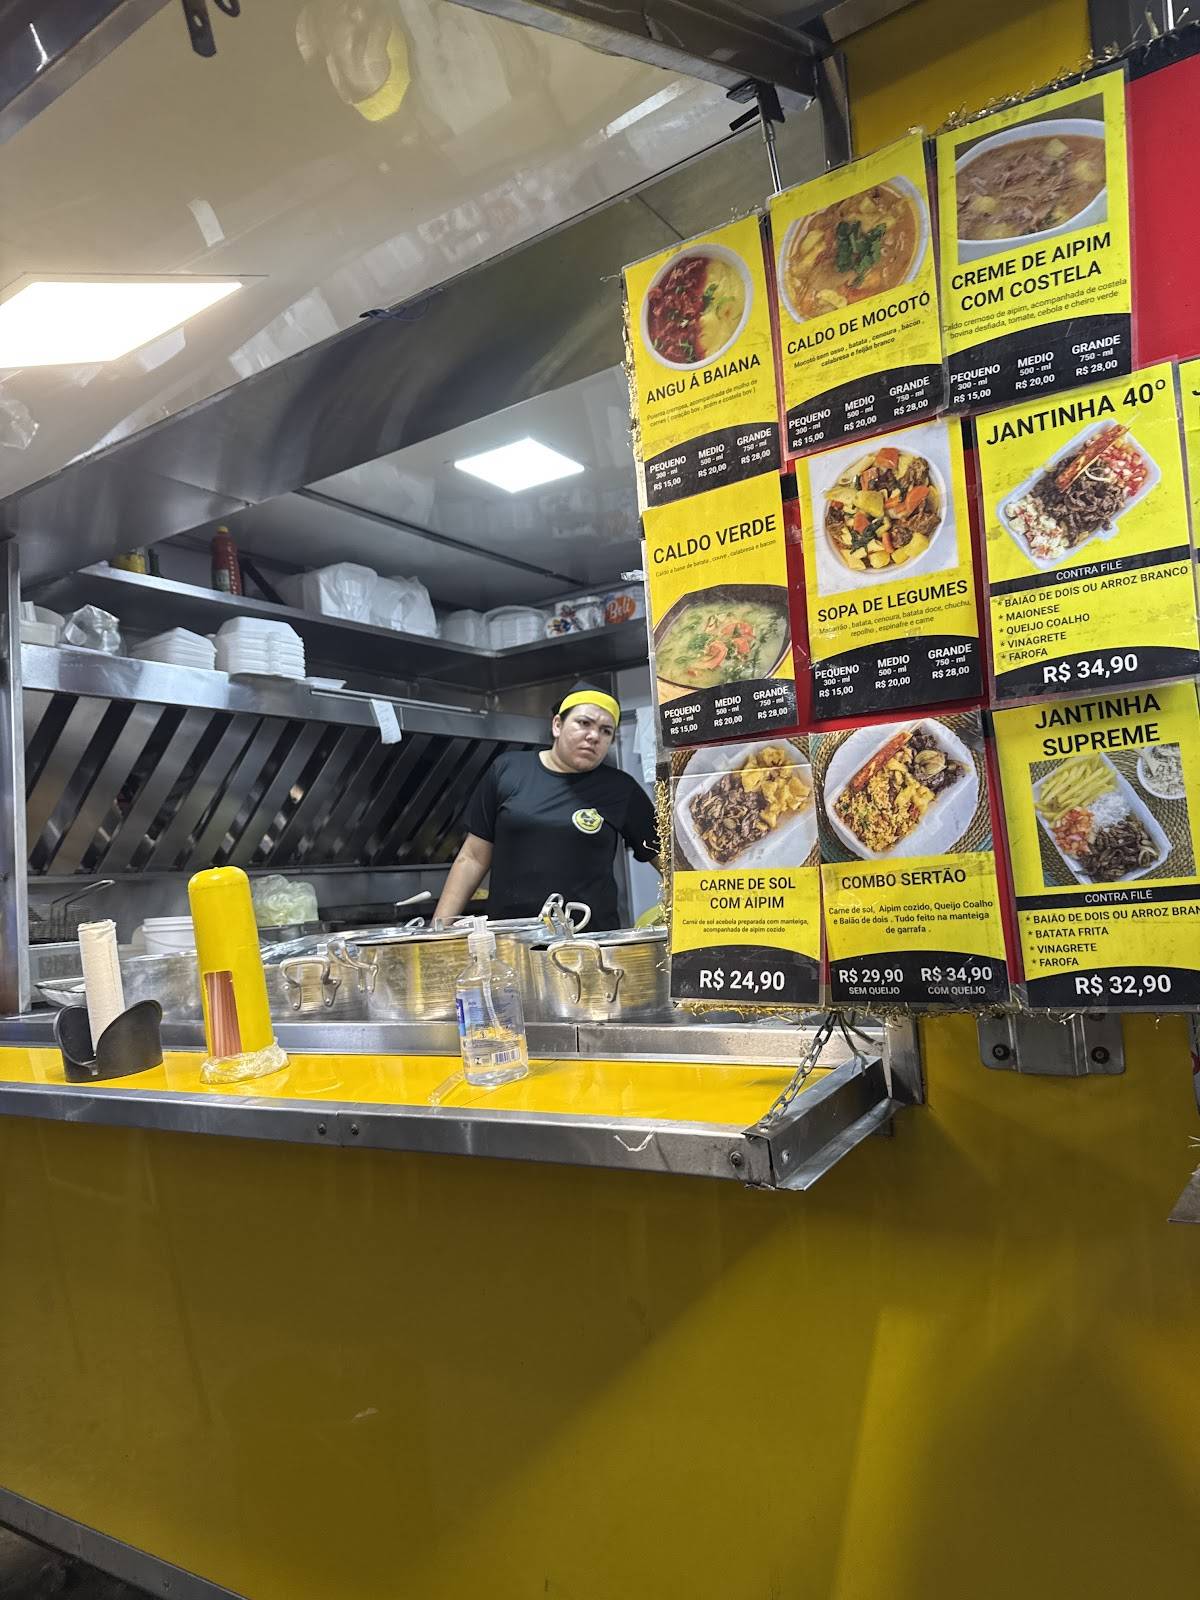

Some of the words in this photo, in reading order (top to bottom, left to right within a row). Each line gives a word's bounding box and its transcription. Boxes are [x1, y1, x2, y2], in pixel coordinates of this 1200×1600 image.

[952, 259, 1016, 290] CREME
[1022, 251, 1046, 271] DE
[1052, 232, 1111, 262] AIPIM
[961, 286, 1003, 311] COM
[1010, 261, 1101, 297] COSTELA
[964, 314, 994, 327] cremoso
[1030, 290, 1085, 309] acompanhada
[1086, 286, 1096, 294] de
[1098, 278, 1127, 291] costela
[787, 328, 834, 354] CALDO
[840, 319, 858, 336] DE
[863, 291, 930, 328] MOCOTÓ
[950, 328, 973, 339] bovina
[1037, 306, 1062, 317] cebola
[1071, 297, 1095, 308] cheiro
[1097, 291, 1118, 302] verde
[1072, 335, 1121, 355] GRANDE
[1017, 352, 1054, 368] MEDIO
[1076, 366, 1088, 376] R$
[1091, 360, 1117, 373] 28,00
[647, 380, 685, 404] ANGU
[690, 373, 700, 389] Á
[704, 354, 760, 384] BAIANA
[951, 364, 1000, 383] PEQUENO
[889, 376, 930, 396] GRANDE
[1016, 380, 1028, 390] R$
[1030, 374, 1055, 387] 20,00
[845, 395, 875, 411] MEDIO
[954, 394, 965, 403] R$
[968, 389, 991, 400] 15,00
[894, 407, 904, 416] R$
[906, 399, 928, 412] 28,00
[789, 409, 831, 429] PEQUENO
[844, 422, 854, 431] R$
[856, 415, 877, 428] 20,00
[987, 395, 1115, 445] JANTINHA
[737, 428, 771, 446] GRANDE
[793, 438, 803, 447] R$
[804, 432, 824, 444] 15,00
[698, 444, 724, 458] MEDIO
[741, 456, 750, 464] R$
[751, 449, 770, 462] 28,00
[650, 455, 686, 473] PEQUENO
[698, 469, 707, 478] R$
[708, 463, 727, 474] 20,00
[663, 477, 681, 488] 15,00
[654, 535, 710, 564] CALDO
[716, 514, 776, 546] VERDE
[1056, 564, 1099, 581] CONTRA
[1039, 591, 1052, 601] DE
[1055, 586, 1079, 598] DOIS
[1083, 583, 1098, 593] OU
[1100, 575, 1137, 590] ARROZ
[1141, 566, 1188, 583] BRANCO
[818, 603, 858, 622] SOPA
[863, 597, 883, 613] DE
[888, 580, 968, 608] LEGUMES
[903, 609, 923, 618] batata
[1006, 604, 1060, 622] MAIONESE
[1007, 620, 1044, 635] QUEIJO
[1047, 613, 1090, 628] COALHO
[1008, 631, 1066, 649] VINAGRETE
[928, 644, 972, 659] GRANDE
[1009, 647, 1048, 661] FAROFA
[877, 655, 910, 668] MEDIO
[1043, 662, 1071, 684] R$
[1078, 653, 1137, 679] 34,90
[815, 665, 859, 679] PEQUENO
[932, 671, 944, 679] R$
[946, 666, 970, 677] 28,00
[832, 686, 853, 695] 15,00
[875, 681, 886, 689] R$
[888, 677, 910, 687] 20,00
[753, 686, 789, 701] GRANDE
[715, 696, 741, 708] MEDIO
[665, 704, 701, 718] PEQUENO
[758, 711, 767, 719] R$
[769, 707, 787, 717] 28,00
[1035, 693, 1161, 729] JANTINHA
[714, 719, 723, 727] R$
[724, 715, 743, 725] 20,00
[671, 727, 679, 735] R$
[680, 724, 698, 733] 15,00
[1043, 723, 1160, 756] SUPREME
[700, 879, 744, 891] CARNE
[748, 878, 765, 889] DE
[769, 877, 795, 889] SOL
[842, 874, 896, 889] COMBO
[901, 868, 966, 886] SERTÃO
[710, 897, 740, 909] COM
[745, 897, 784, 908] AIPIM
[1085, 892, 1128, 903] CONTRA
[879, 904, 901, 913] Aipim
[903, 903, 932, 911] cozido,
[934, 902, 960, 911] Queijo
[963, 900, 993, 908] Coalho
[1068, 913, 1082, 921] DE
[1085, 911, 1109, 920] DOIS
[1113, 910, 1128, 918] OU
[1131, 908, 1168, 918] ARROZ
[1172, 906, 1200, 916] BRAN
[873, 915, 888, 923] dois
[917, 913, 935, 921] feito
[949, 912, 989, 921] manteiga
[897, 925, 926, 934] garrafa
[1036, 929, 1075, 938] BATATA
[1078, 927, 1108, 936] FRITA
[1038, 943, 1097, 953] VINAGRETE
[1040, 958, 1078, 967] FAROFA
[700, 968, 724, 990] R$
[730, 970, 785, 993] 24,90
[839, 968, 858, 984] R$
[862, 969, 903, 986] 29,90
[921, 966, 942, 982] R$
[946, 967, 992, 984] 34,90
[869, 986, 900, 995] QUEIJO
[951, 986, 985, 994] QUEIJO
[1075, 974, 1103, 996] R$
[1109, 974, 1171, 997] 32,90
